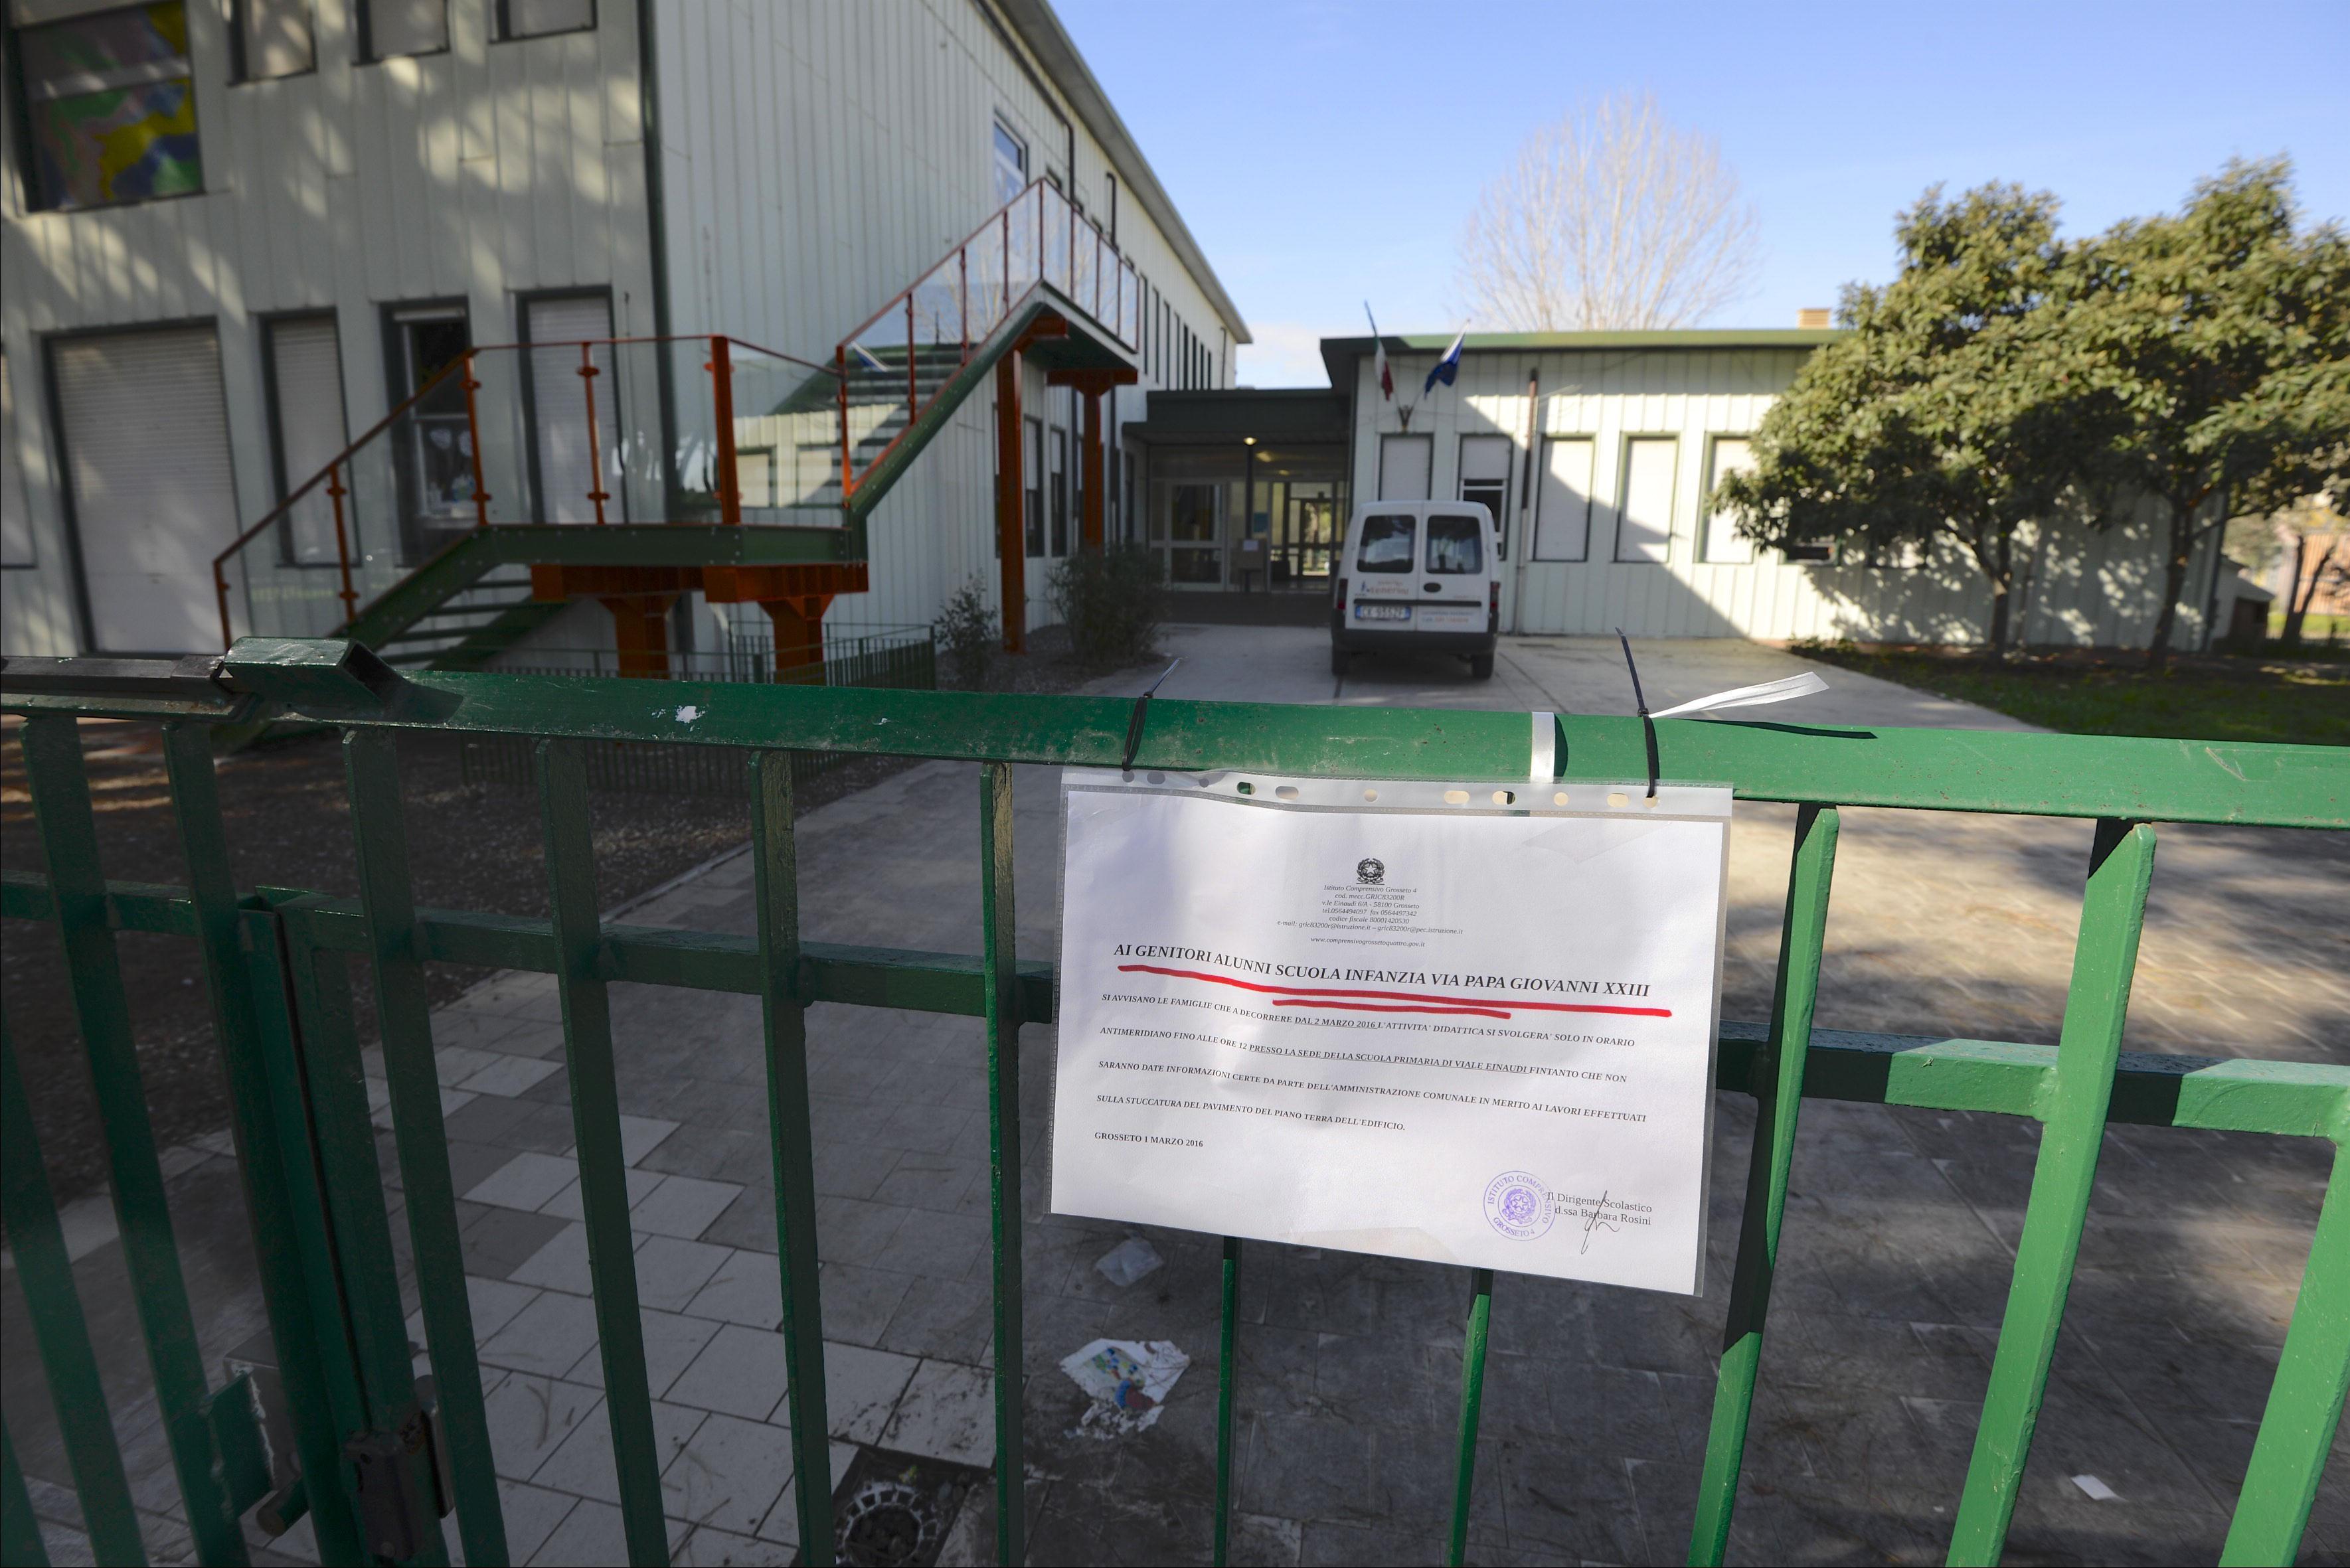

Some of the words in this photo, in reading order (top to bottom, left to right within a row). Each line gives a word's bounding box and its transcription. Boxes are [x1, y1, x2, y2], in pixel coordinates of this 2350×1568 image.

[1311, 937, 1426, 947] www.comprensivogrossetoquattro.gov.it
[1114, 944, 1132, 956] AI
[1135, 945, 1212, 963] GENITORI
[1214, 954, 1271, 974] ALUNNI
[1276, 965, 1341, 980] SCUOLA
[1345, 969, 1425, 984] INFANZIA
[1431, 973, 1460, 986] VIA
[1464, 975, 1505, 988] PAPA
[1511, 978, 1598, 993] GIOVANNI
[1603, 982, 1651, 996] XXIII
[1110, 994, 1155, 1004] AVVISANO
[1171, 998, 1213, 1009] FAMIGLIE
[1215, 1004, 1231, 1012] CHE
[1240, 1009, 1292, 1023] DECORRERE
[1377, 1022, 1431, 1032] L'ATTIVITA'
[1433, 1026, 1484, 1036] DIDATTICA
[1497, 1029, 1552, 1040] SVOLGERA'
[1596, 1037, 1635, 1047] ORARIO
[1100, 1027, 1171, 1038] ANTIMERIDIANO
[1197, 1034, 1218, 1044] ALLE
[1220, 1038, 1237, 1047] ORE
[1250, 1044, 1282, 1054] PRESSO
[1298, 1049, 1321, 1058] SEDE
[1324, 1052, 1353, 1060] DELLA
[1356, 1054, 1391, 1063] SCUOLA
[1394, 1056, 1440, 1065] PRIMARIA
[1455, 1061, 1483, 1069] VIALE
[1485, 1063, 1527, 1073] EINAUDI
[1529, 1066, 1578, 1078] FINTANTO
[1581, 1071, 1602, 1080] CHE
[1605, 1073, 1627, 1083] NON
[1098, 1061, 1139, 1070] SARANNO
[1142, 1063, 1164, 1072] DATE
[1166, 1065, 1230, 1079] INFORMAZIONI
[1232, 1073, 1261, 1083] CERTE
[1278, 1079, 1304, 1089] PARTE
[1307, 1083, 1420, 1098] DELL'AMMINISTRAZIONE
[1424, 1091, 1476, 1103] COMUNALE
[1492, 1098, 1530, 1109] MERITO
[1545, 1105, 1581, 1115] LAVORI
[1584, 1109, 1647, 1122] EFFETTUATI
[1096, 1095, 1124, 1104] SULLA
[1126, 1097, 1181, 1107] STUCCATURA
[1203, 1103, 1253, 1113] PAVIMENTO
[1274, 1110, 1301, 1119] PIANO
[1304, 1114, 1333, 1123] TERRA
[1335, 1116, 1405, 1131] DELL'EDIFICIO.
[1094, 1132, 1142, 1142] GROSSETO
[1151, 1137, 1183, 1146] MARZO
[1487, 1176, 1515, 1205] ISTITUTO
[1548, 1192, 1554, 1201] Il
[1557, 1193, 1602, 1206] Dirigente
[1604, 1200, 1652, 1213] Scolastico
[1493, 1217, 1530, 1237] GROSSETO
[1555, 1206, 1577, 1216] d.ssa
[1581, 1209, 1618, 1221] Barbara
[1621, 1215, 1651, 1225] Rosini
